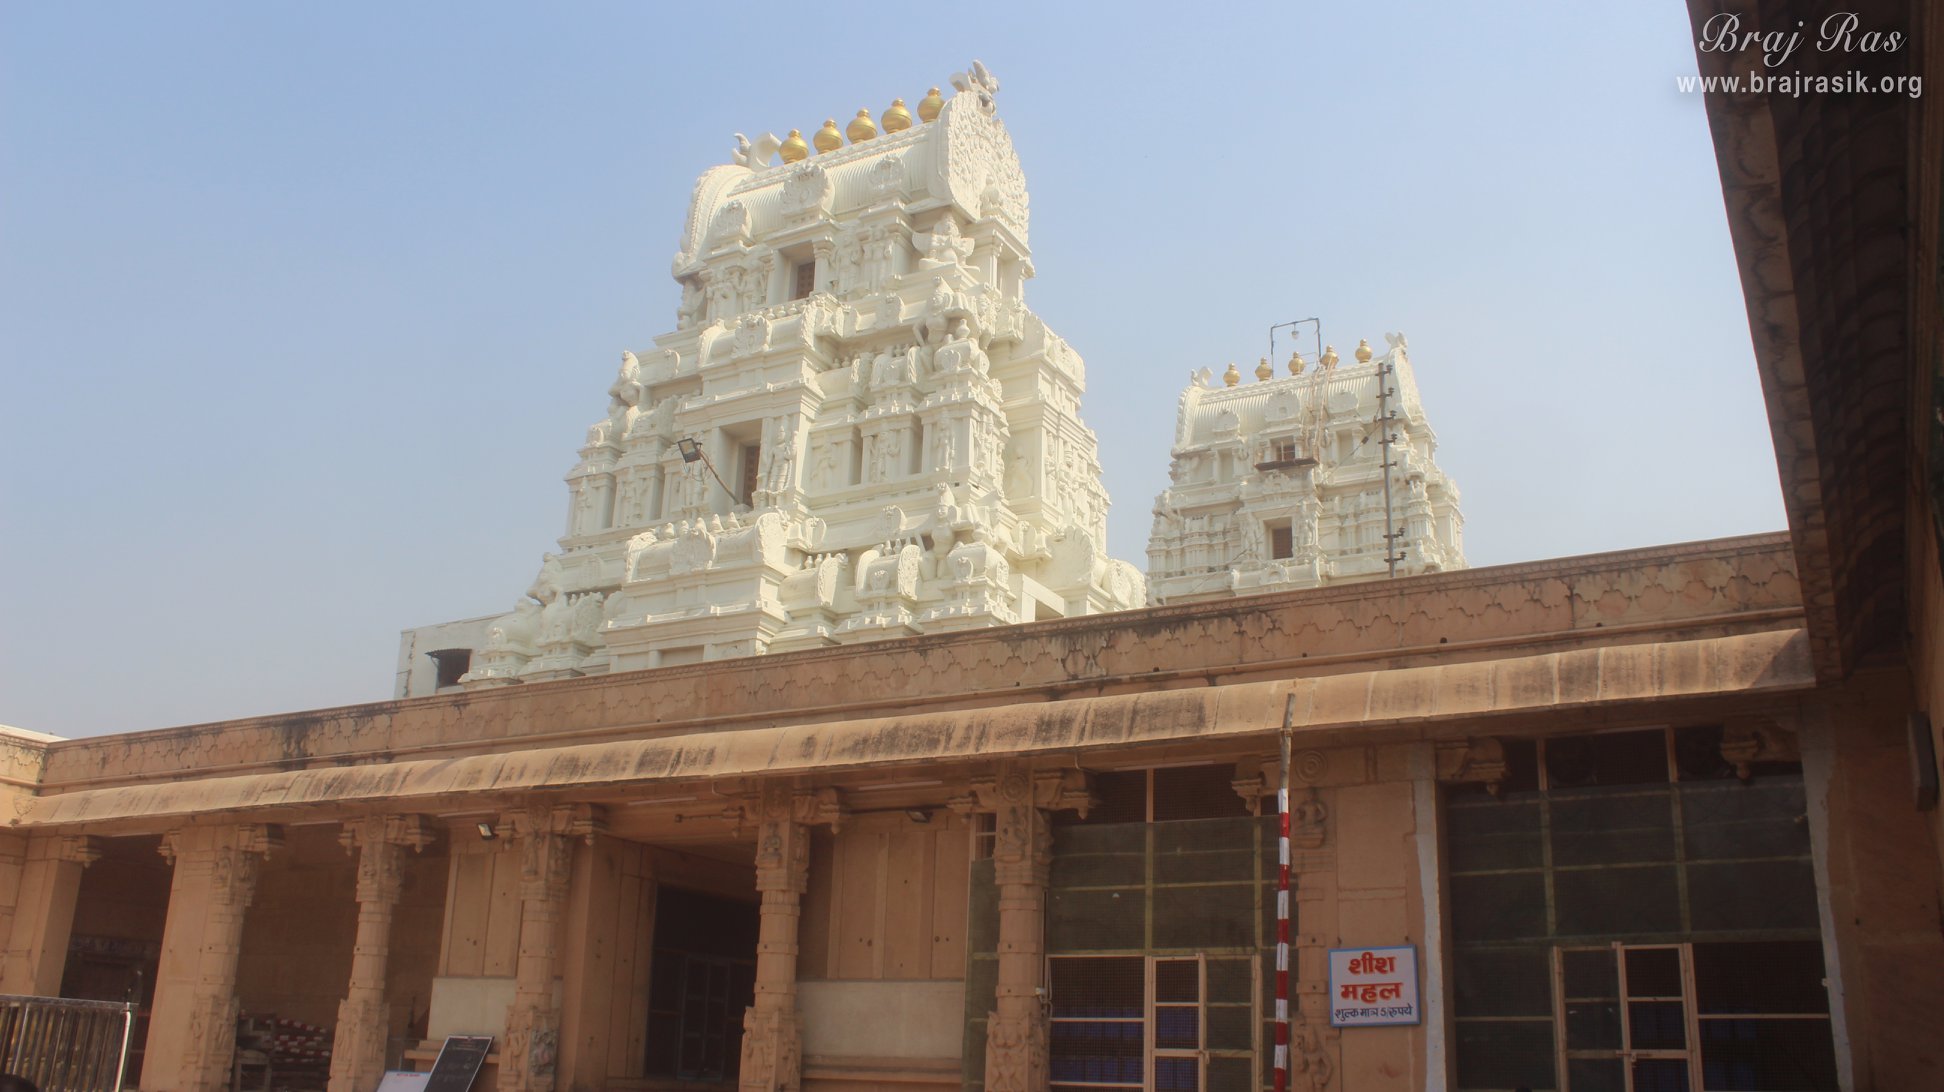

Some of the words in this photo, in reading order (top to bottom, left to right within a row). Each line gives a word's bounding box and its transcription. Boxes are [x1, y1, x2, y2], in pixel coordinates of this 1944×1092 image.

[1348, 951, 1397, 975] शीश
[1340, 982, 1403, 1004] महल
[1335, 1007, 1359, 1022] शुल्क
[1360, 1006, 1378, 1018] मात्र
